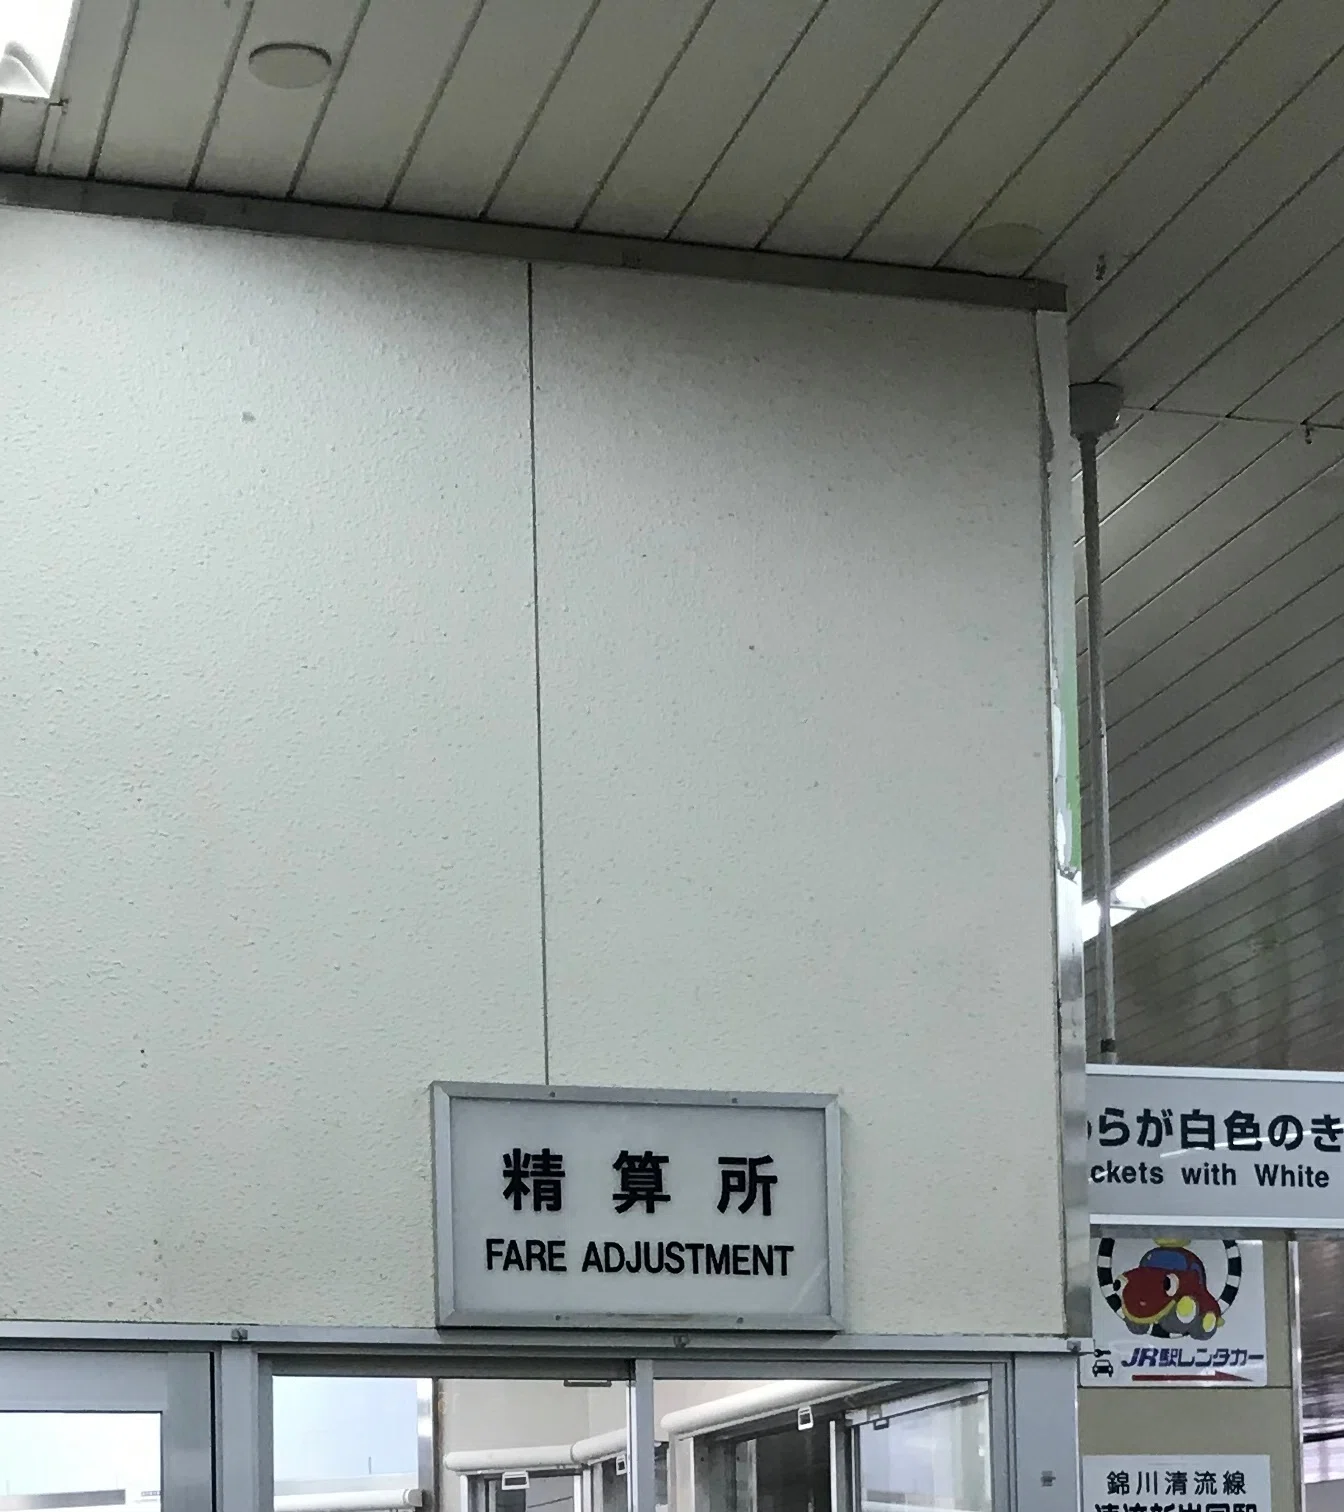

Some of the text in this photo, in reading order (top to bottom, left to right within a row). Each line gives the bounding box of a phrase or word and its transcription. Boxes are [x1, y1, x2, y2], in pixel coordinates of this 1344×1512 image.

[502, 1148, 778, 1217] 精算所
[1181, 1162, 1237, 1187] with
[1255, 1164, 1330, 1188] White
[486, 1238, 794, 1277] FARE ADJUSTMENT
[1121, 1347, 1264, 1367] JR駅レンタカー
[1107, 1470, 1247, 1496] 錦川清流線
